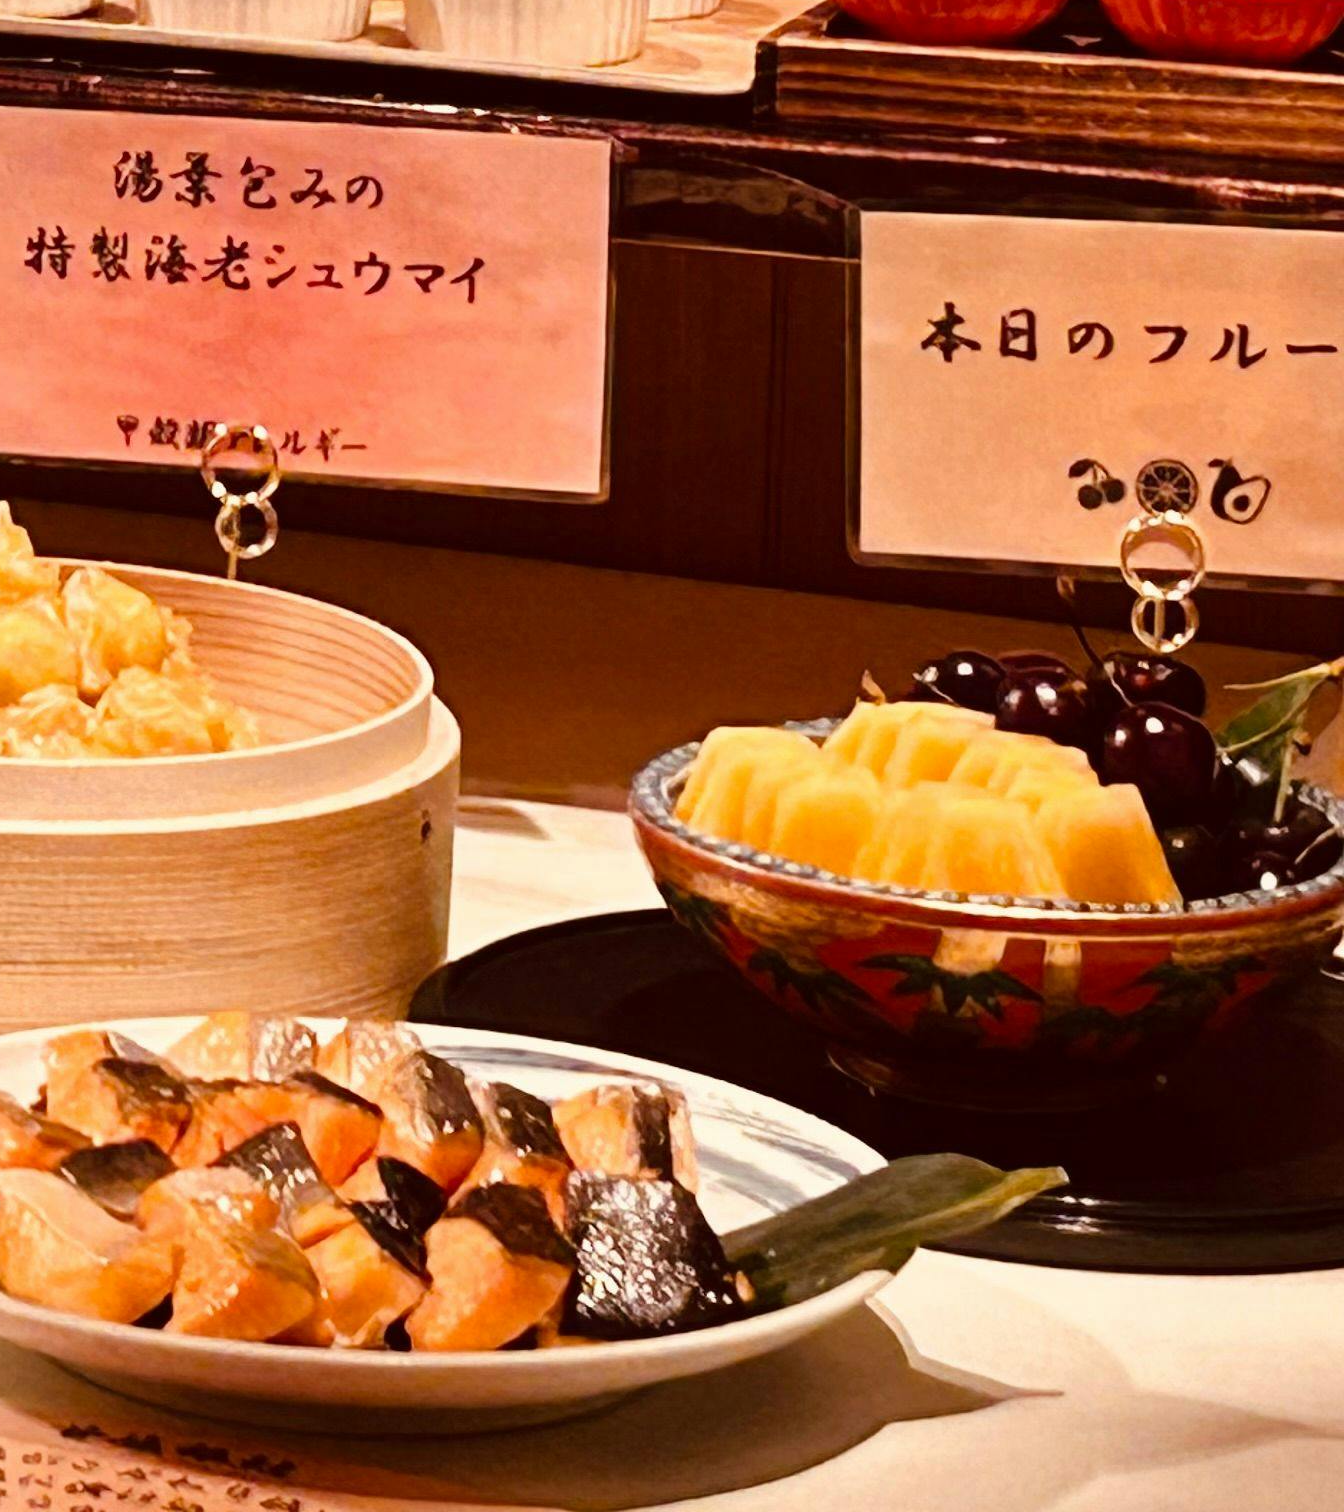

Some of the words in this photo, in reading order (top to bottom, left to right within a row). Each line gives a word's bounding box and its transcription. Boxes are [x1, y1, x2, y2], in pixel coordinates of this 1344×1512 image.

[25, 226, 486, 303] 特製海老シュウマイ
[921, 301, 1339, 369] 本日のフルー
